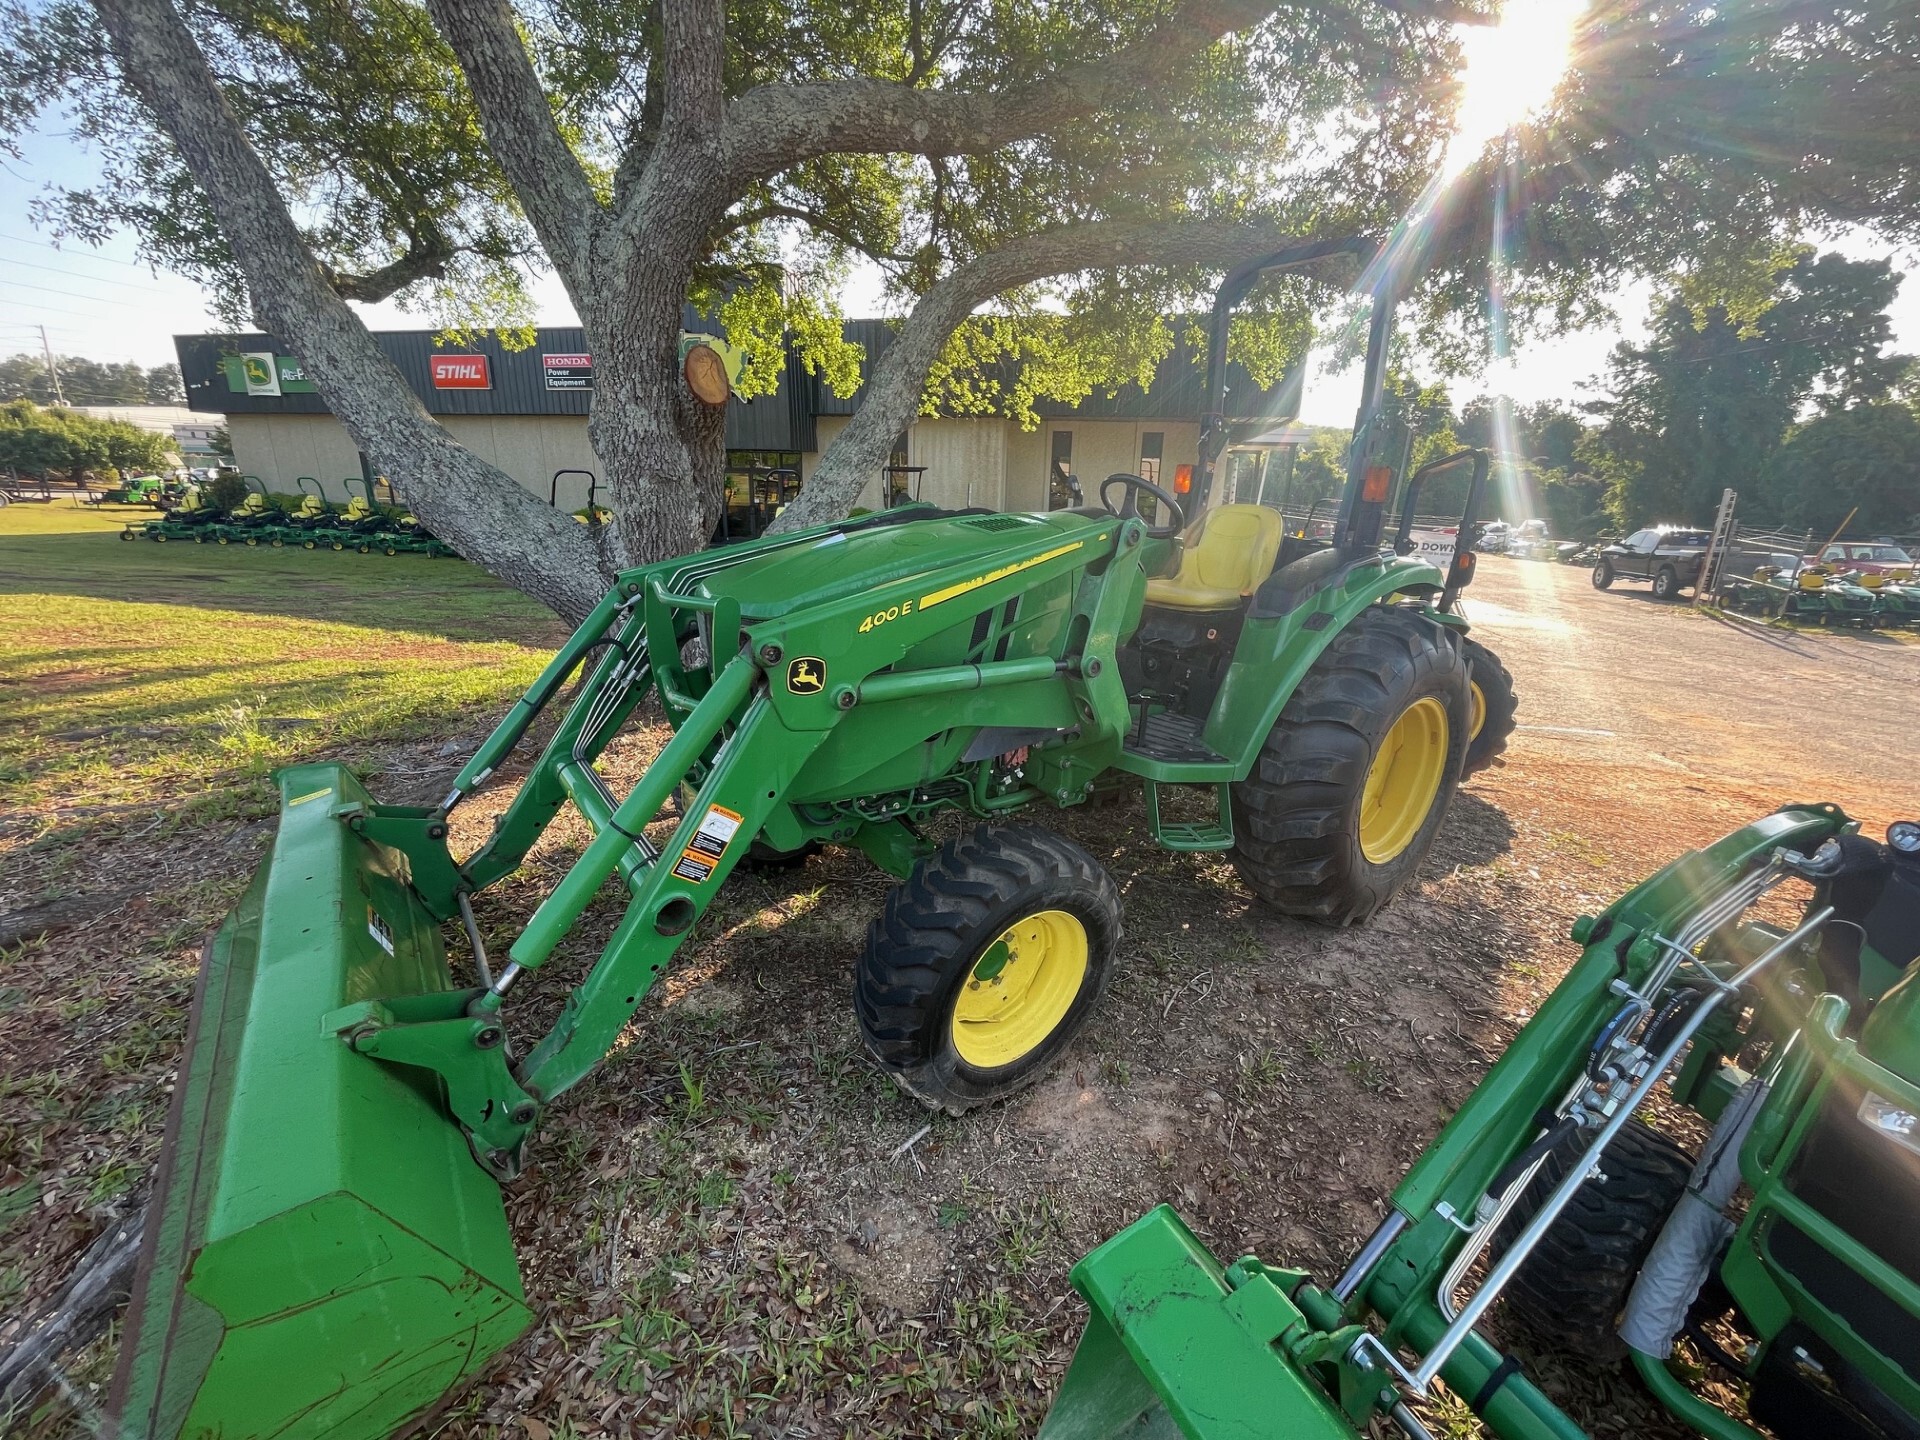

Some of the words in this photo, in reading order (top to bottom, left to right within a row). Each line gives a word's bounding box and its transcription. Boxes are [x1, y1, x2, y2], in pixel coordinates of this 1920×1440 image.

[546, 357, 589, 366] HONDA
[436, 365, 481, 379] STIHL
[547, 368, 570, 376] Power
[549, 379, 586, 388] Equipment
